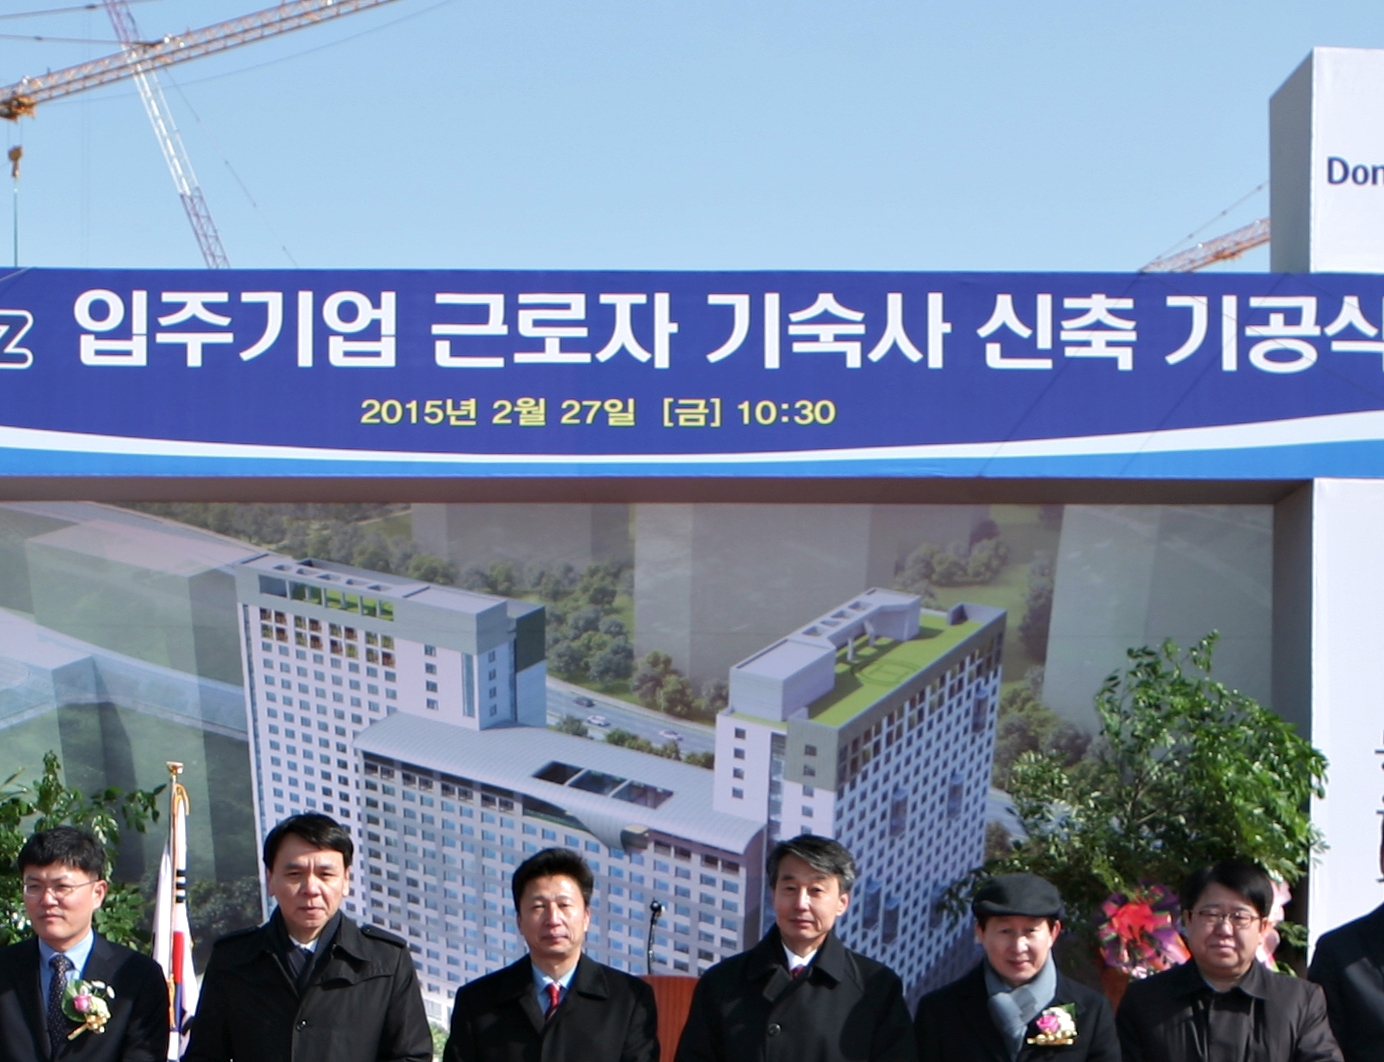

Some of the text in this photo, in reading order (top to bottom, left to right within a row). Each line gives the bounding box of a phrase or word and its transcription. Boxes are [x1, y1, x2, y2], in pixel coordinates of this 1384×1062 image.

[72, 289, 397, 368] 입주기업
[430, 291, 679, 370] 근로자
[705, 291, 953, 370] 기숙사
[975, 292, 1138, 371] 신축
[360, 397, 837, 427] 2015년 2월 27일 [금] 10:30
